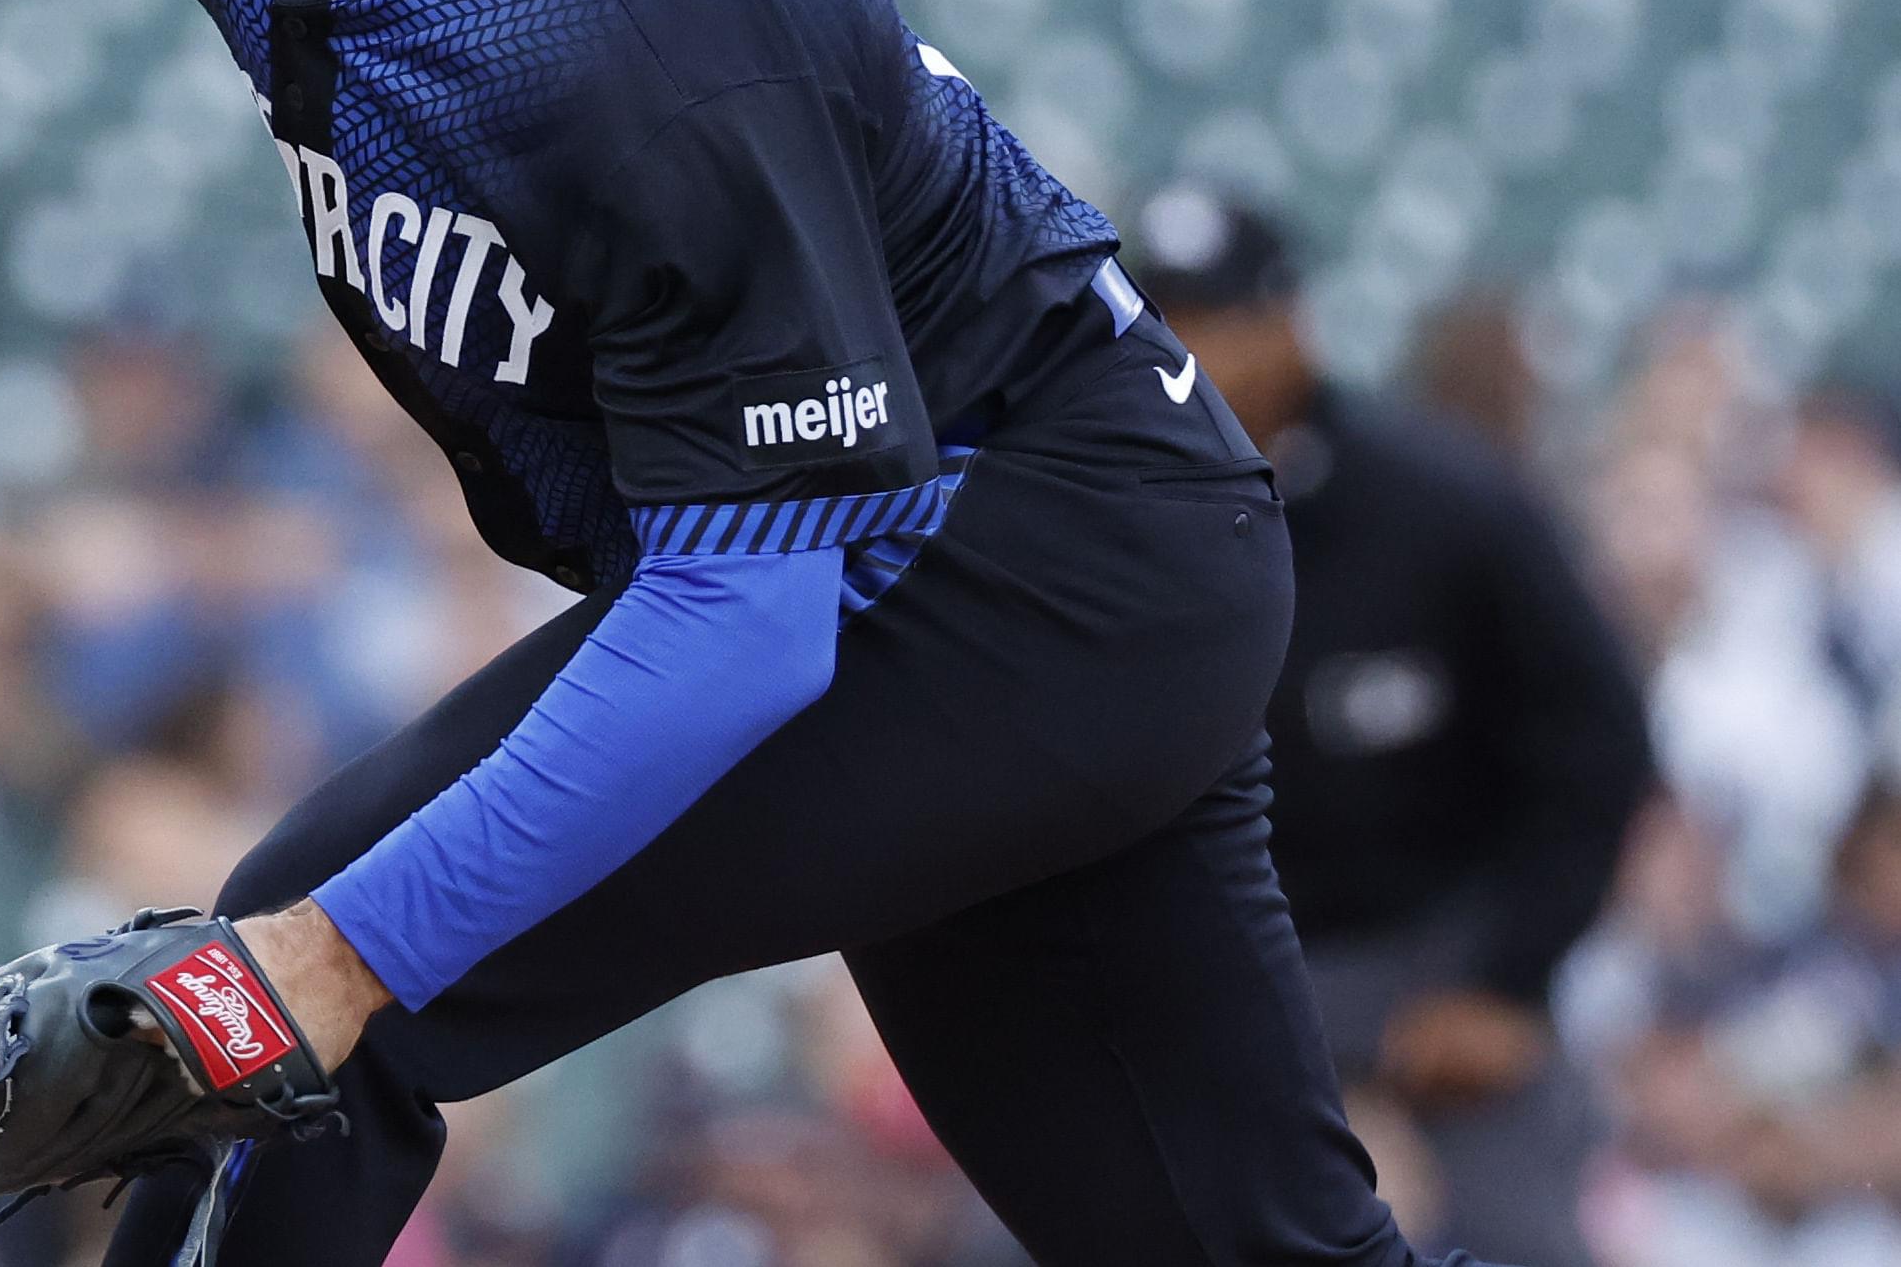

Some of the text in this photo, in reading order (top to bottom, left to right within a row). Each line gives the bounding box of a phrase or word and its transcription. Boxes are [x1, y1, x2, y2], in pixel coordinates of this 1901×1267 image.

[368, 192, 555, 385] CITY
[743, 376, 889, 448] meijer
[177, 973, 264, 1059] Rawlings
